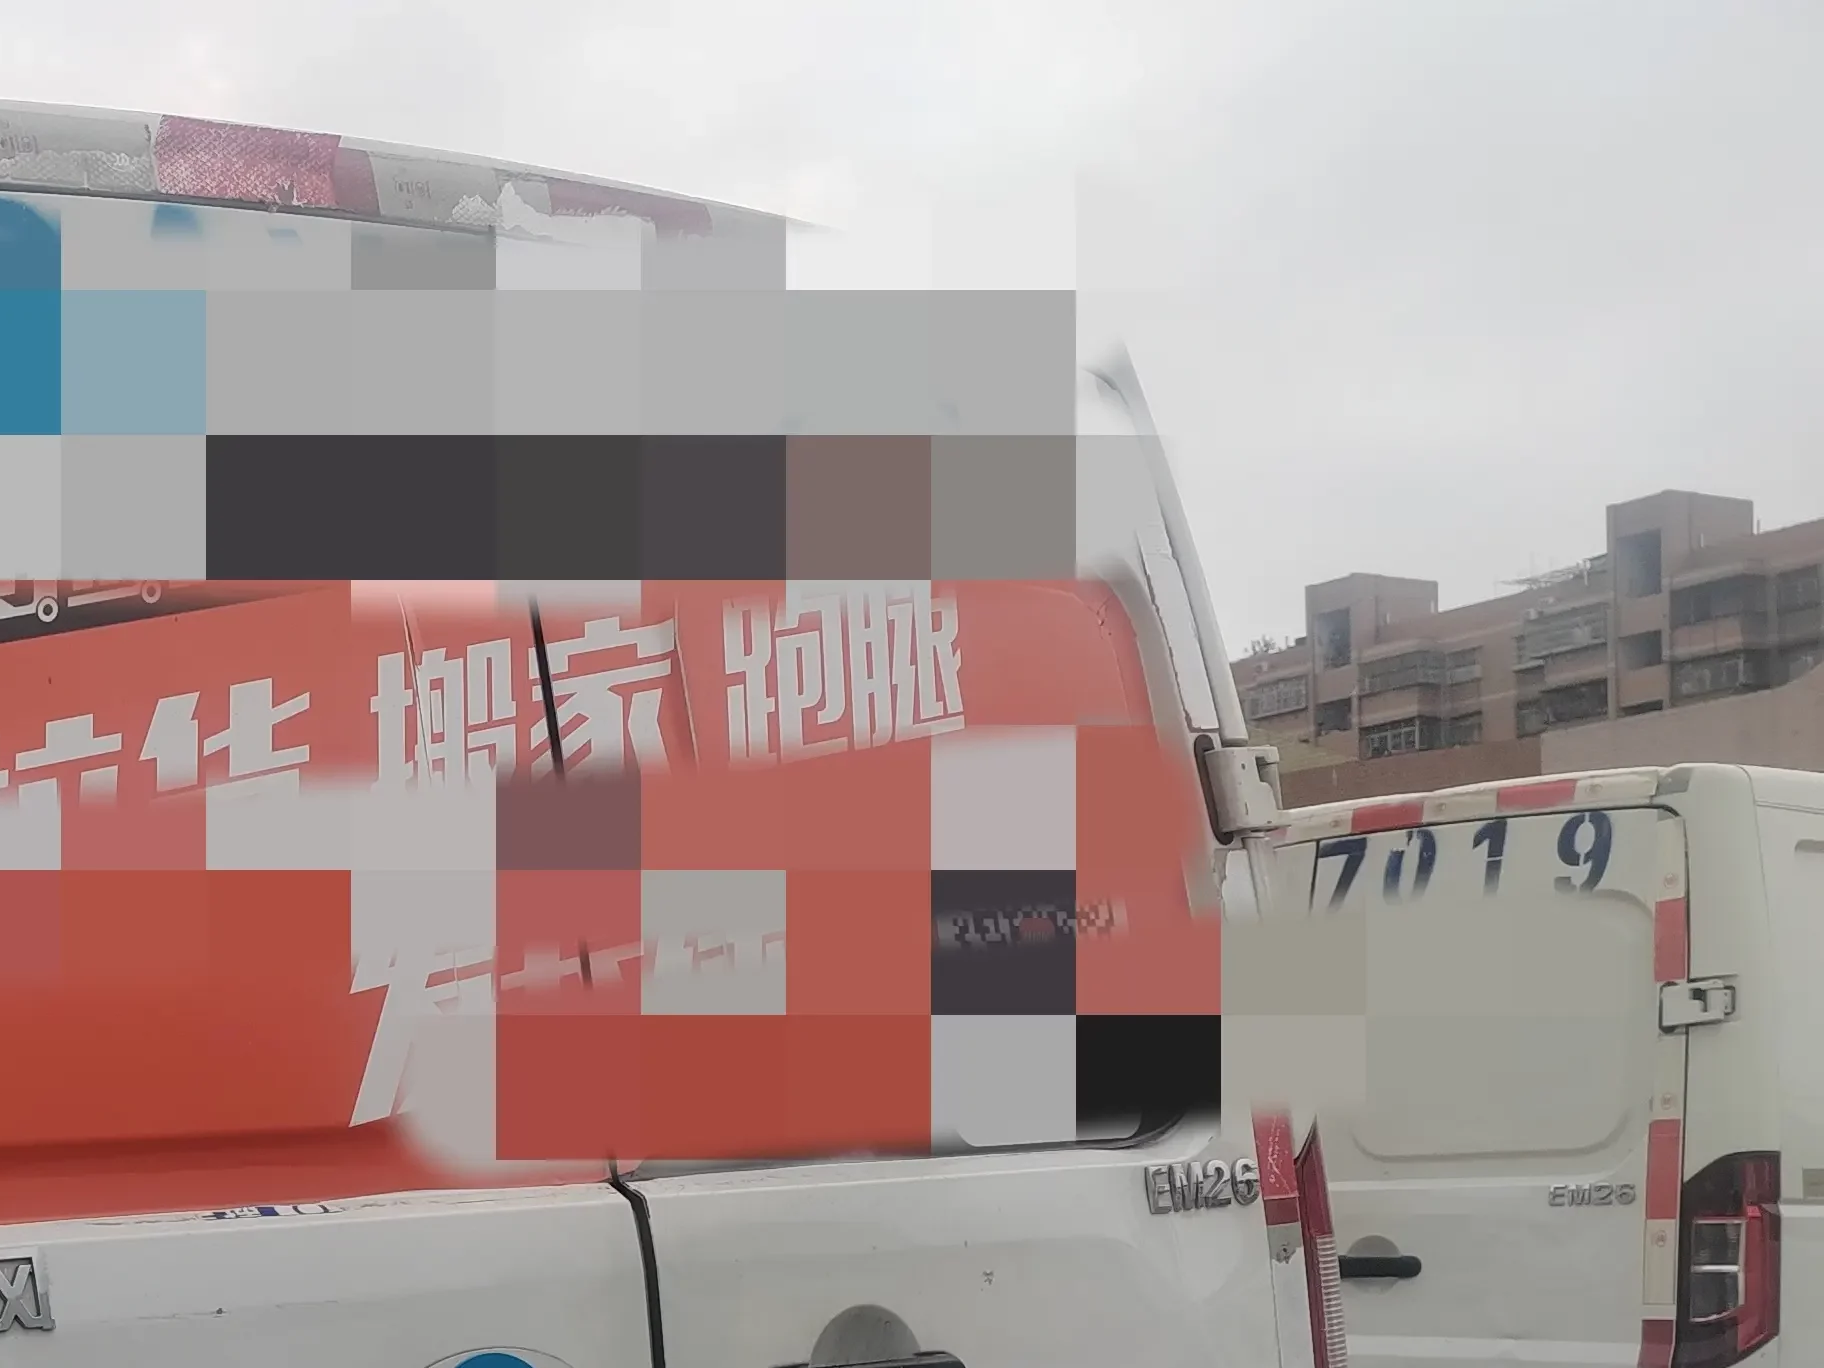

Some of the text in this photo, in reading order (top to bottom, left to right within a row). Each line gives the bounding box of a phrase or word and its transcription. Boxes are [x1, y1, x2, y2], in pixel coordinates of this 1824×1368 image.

[370, 616, 678, 790] 搬家
[722, 588, 966, 765] 跑腿
[1144, 1158, 1259, 1214] EM26
[1548, 1182, 1636, 1206] EM26
